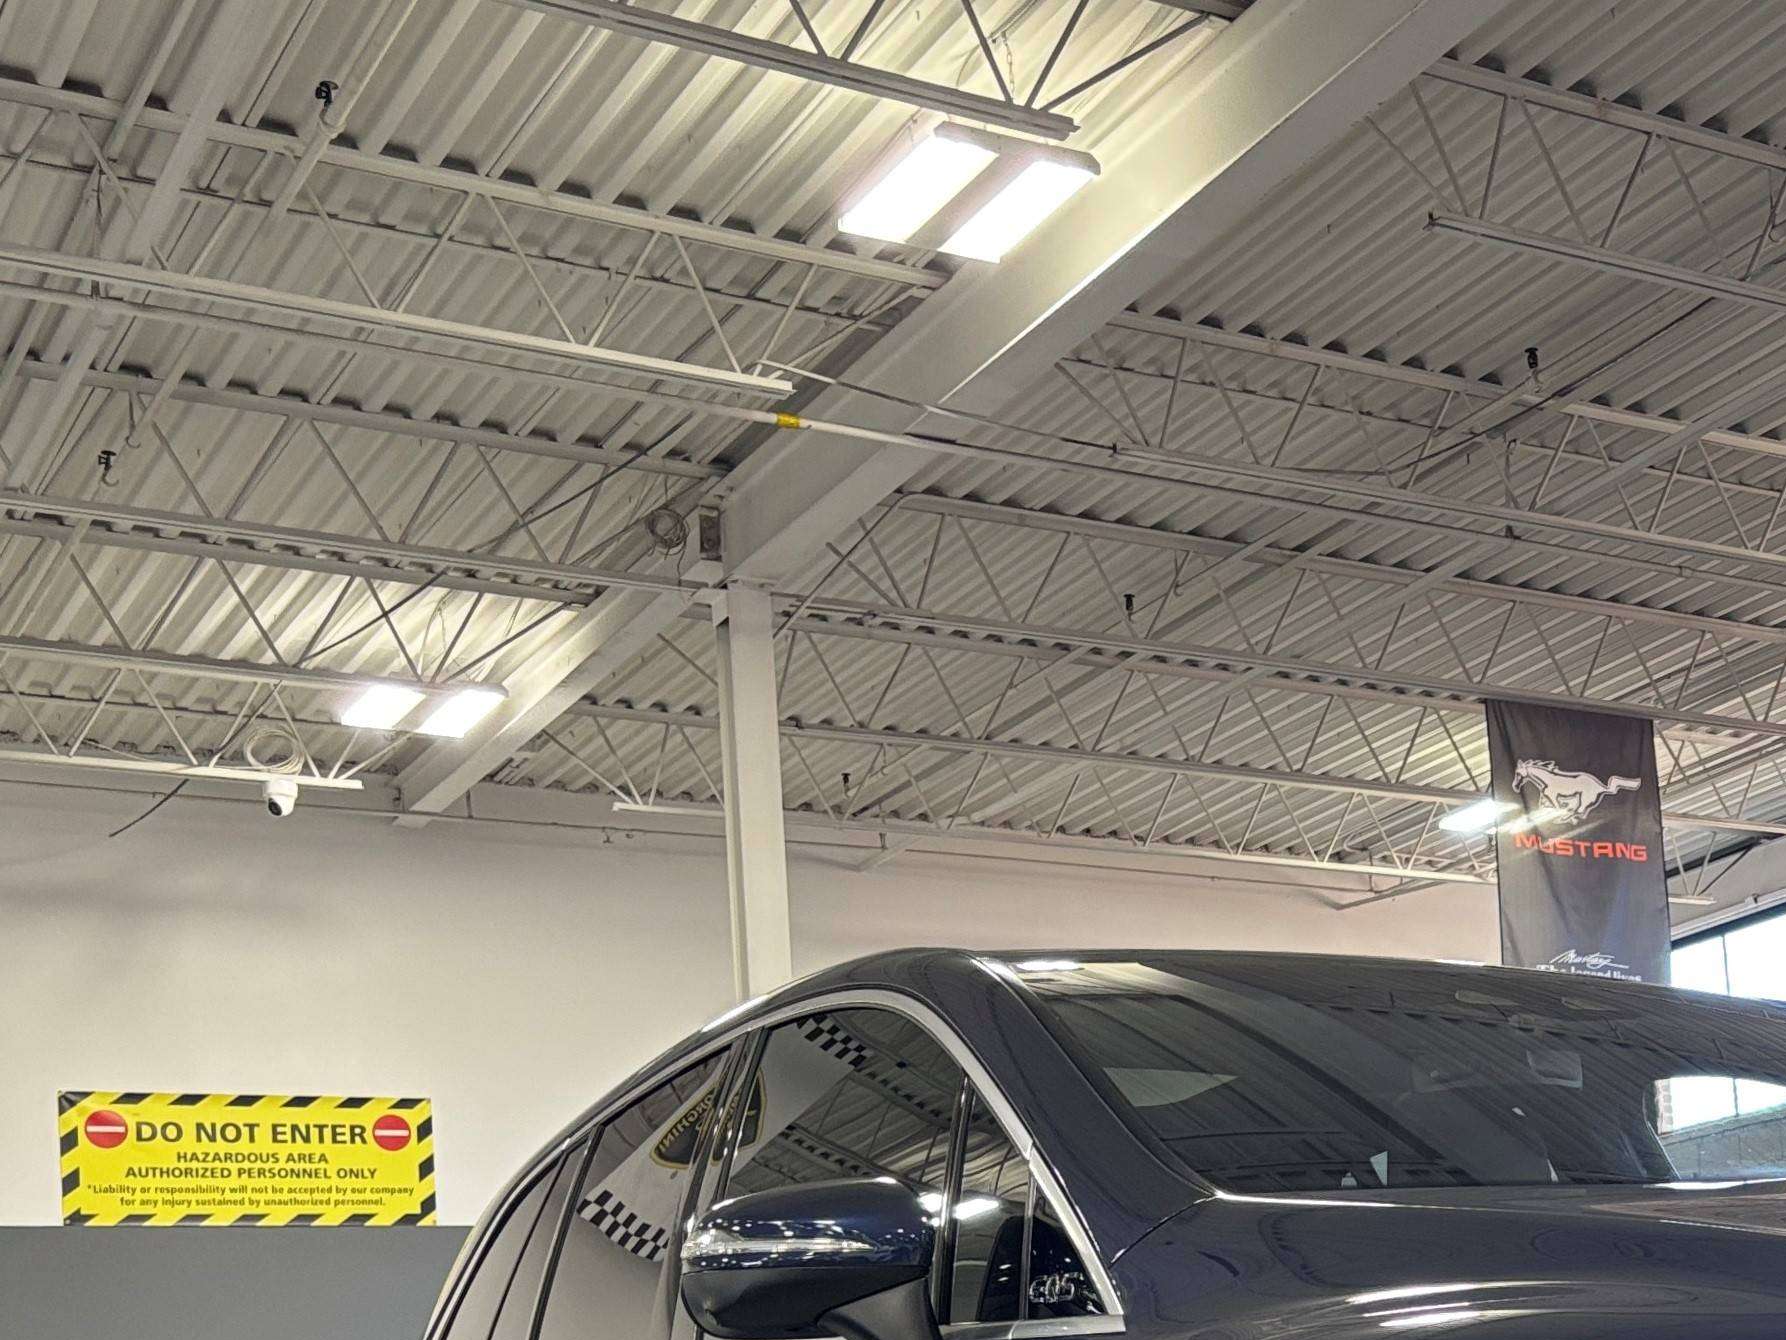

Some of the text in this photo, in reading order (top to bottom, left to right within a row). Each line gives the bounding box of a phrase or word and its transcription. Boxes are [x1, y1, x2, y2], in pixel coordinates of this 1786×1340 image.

[1514, 831, 1648, 861] MUSTANG
[135, 1121, 368, 1145] DO NOT ENTER
[176, 1151, 329, 1164] HAZARDOUS AREA
[125, 1166, 377, 1180] AUTHORIZED PERSONNEL ONLY
[140, 1187, 151, 1195] or
[154, 1185, 226, 1197] responsibility
[228, 1185, 248, 1195] will
[251, 1186, 268, 1195] not
[271, 1185, 284, 1195] be
[287, 1185, 333, 1197] accepted
[335, 1186, 348, 1197] by
[350, 1187, 367, 1195] our
[370, 1187, 415, 1197] company
[120, 1197, 387, 1208] for any injury sustained by unauthorized personnel.
